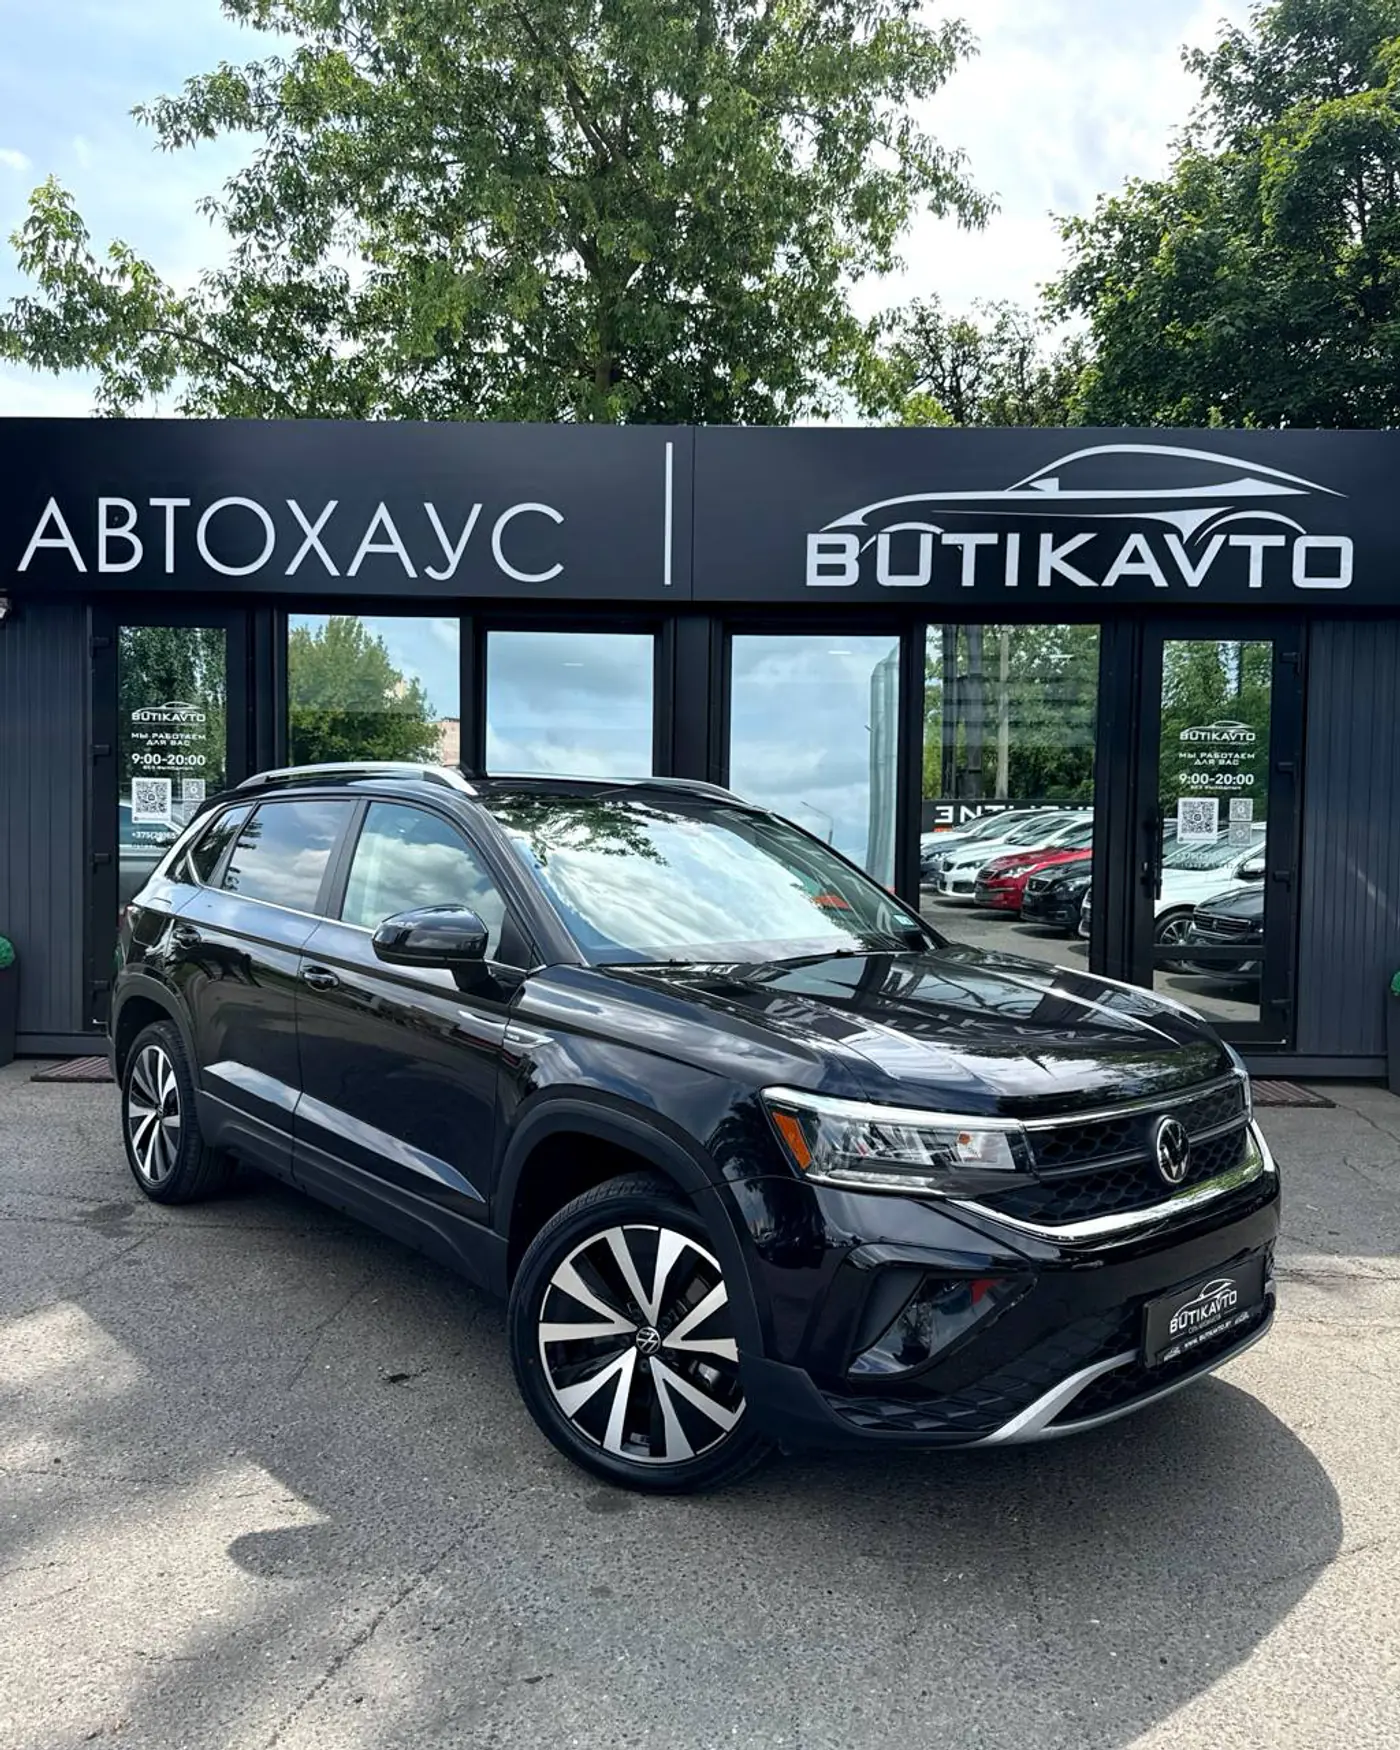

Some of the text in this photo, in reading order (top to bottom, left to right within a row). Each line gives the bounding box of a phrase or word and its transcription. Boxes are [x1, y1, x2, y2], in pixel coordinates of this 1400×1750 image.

[17, 496, 565, 583] АВТОХАУС
[806, 533, 1354, 589] BUTIKAVTO
[131, 711, 206, 722] BUTIKAVTO
[151, 733, 207, 741] РАБОТАЕМ
[1179, 731, 1256, 741] BUTIKAVTO
[131, 753, 206, 766] 9:00-20:00
[1200, 752, 1255, 760] РАБОТАЕМ
[1179, 773, 1254, 785] 9:00-20:00
[1169, 1289, 1238, 1334] BUTIKAVTO
